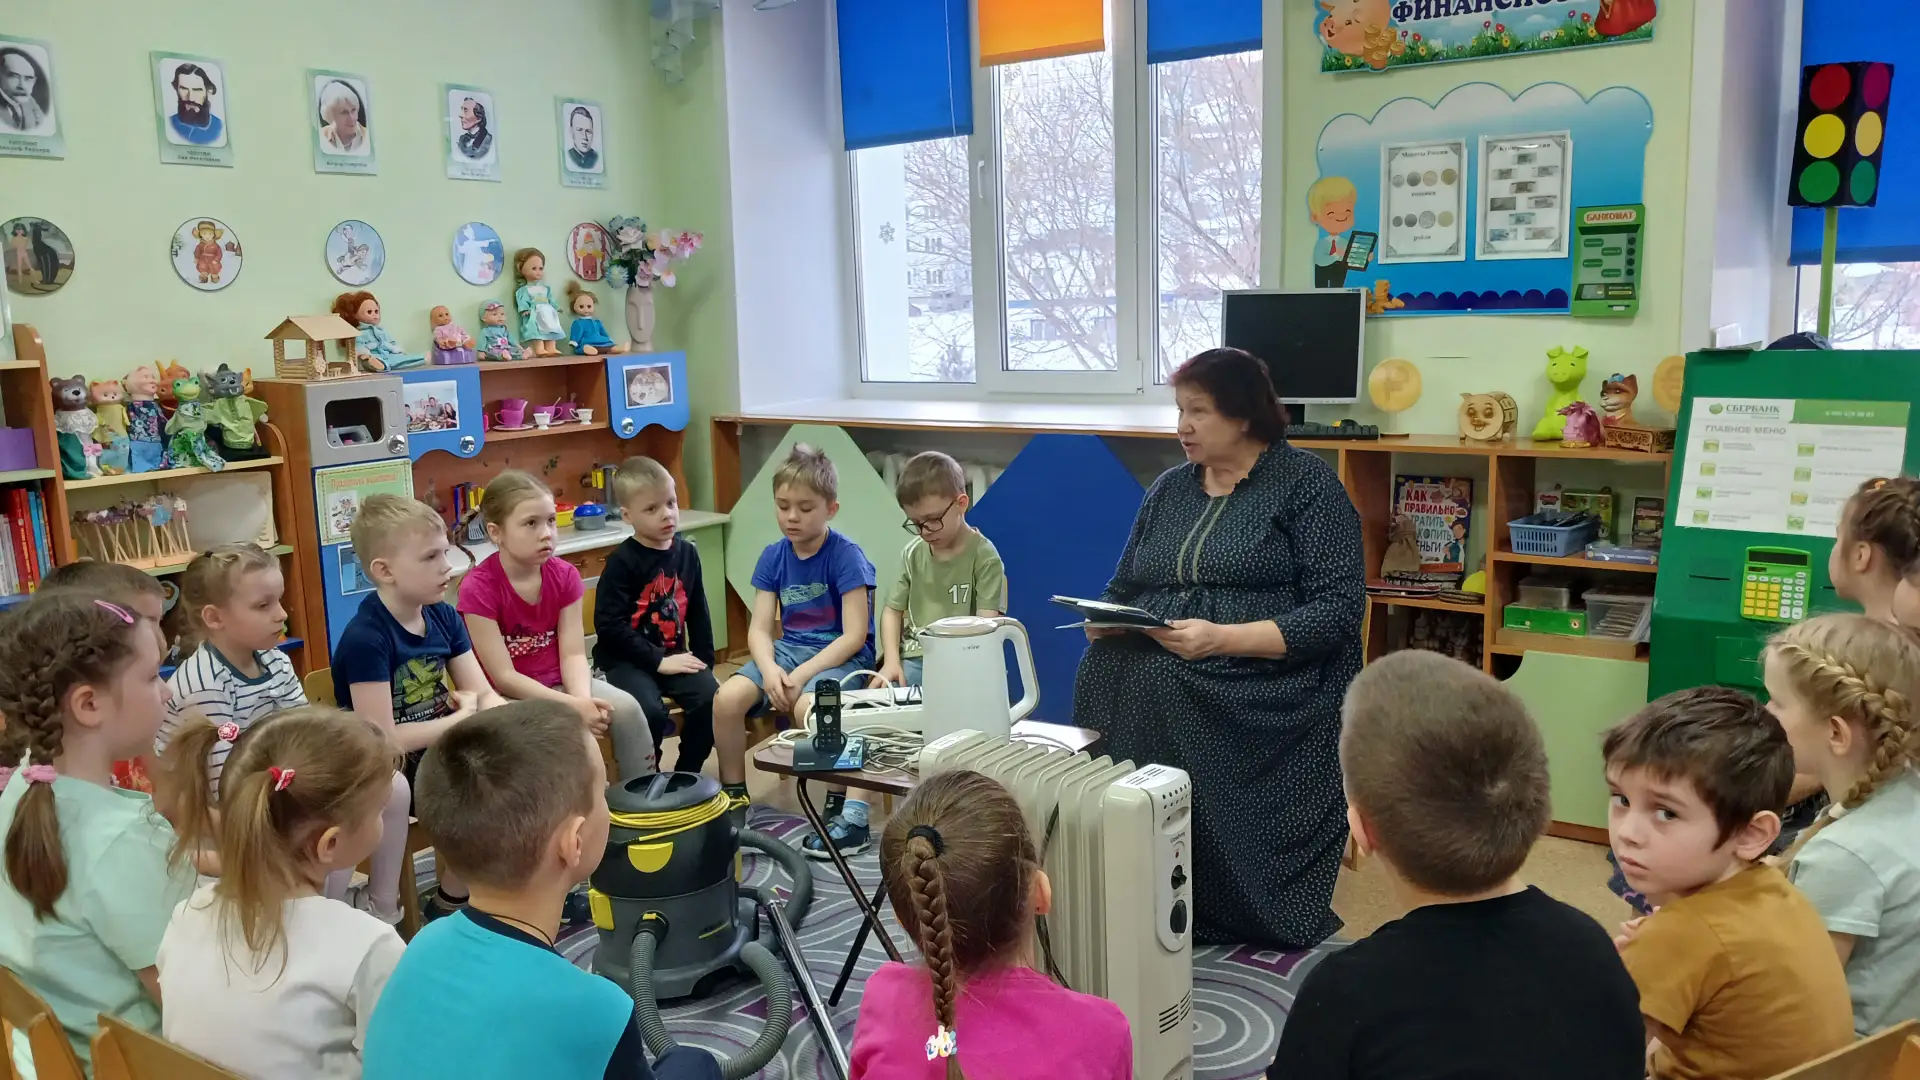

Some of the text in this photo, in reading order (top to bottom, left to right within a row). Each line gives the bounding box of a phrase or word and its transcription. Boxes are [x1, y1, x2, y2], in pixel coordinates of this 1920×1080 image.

[1392, 0, 1567, 22] ФИНАН
[1586, 211, 1634, 221] БАНКОМАТ
[1726, 404, 1780, 413] СБЕРБАНК
[1705, 424, 1787, 435] ГЛАВНОЕ МЕНЮ
[1406, 488, 1427, 501] КАК
[1405, 503, 1455, 515] ПРАВИЛЬНО
[948, 584, 970, 604] 17
